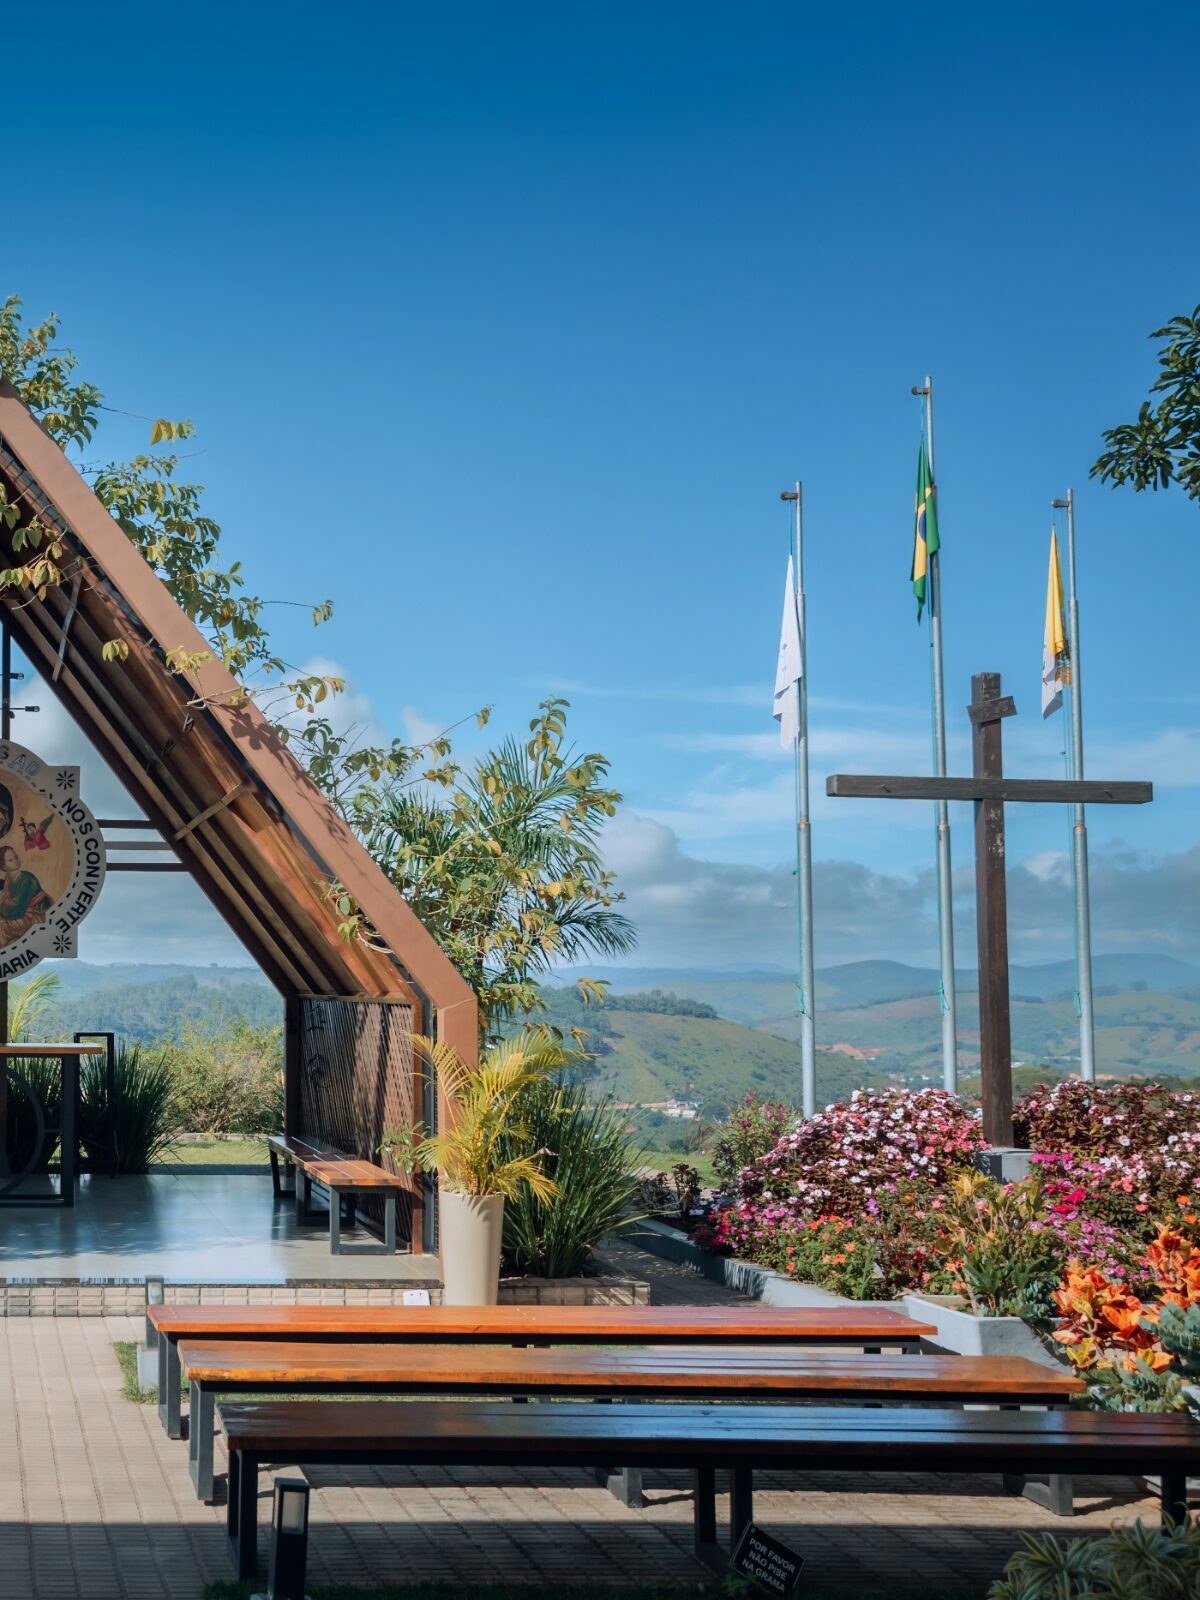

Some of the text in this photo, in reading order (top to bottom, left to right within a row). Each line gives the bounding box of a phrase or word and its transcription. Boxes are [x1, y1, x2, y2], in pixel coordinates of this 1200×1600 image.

[61, 798, 93, 835] NOS
[55, 838, 100, 933] CONVERTE
[749, 1537, 796, 1574] POR FAVOR
[742, 1558, 785, 1593] NA GRAMA
